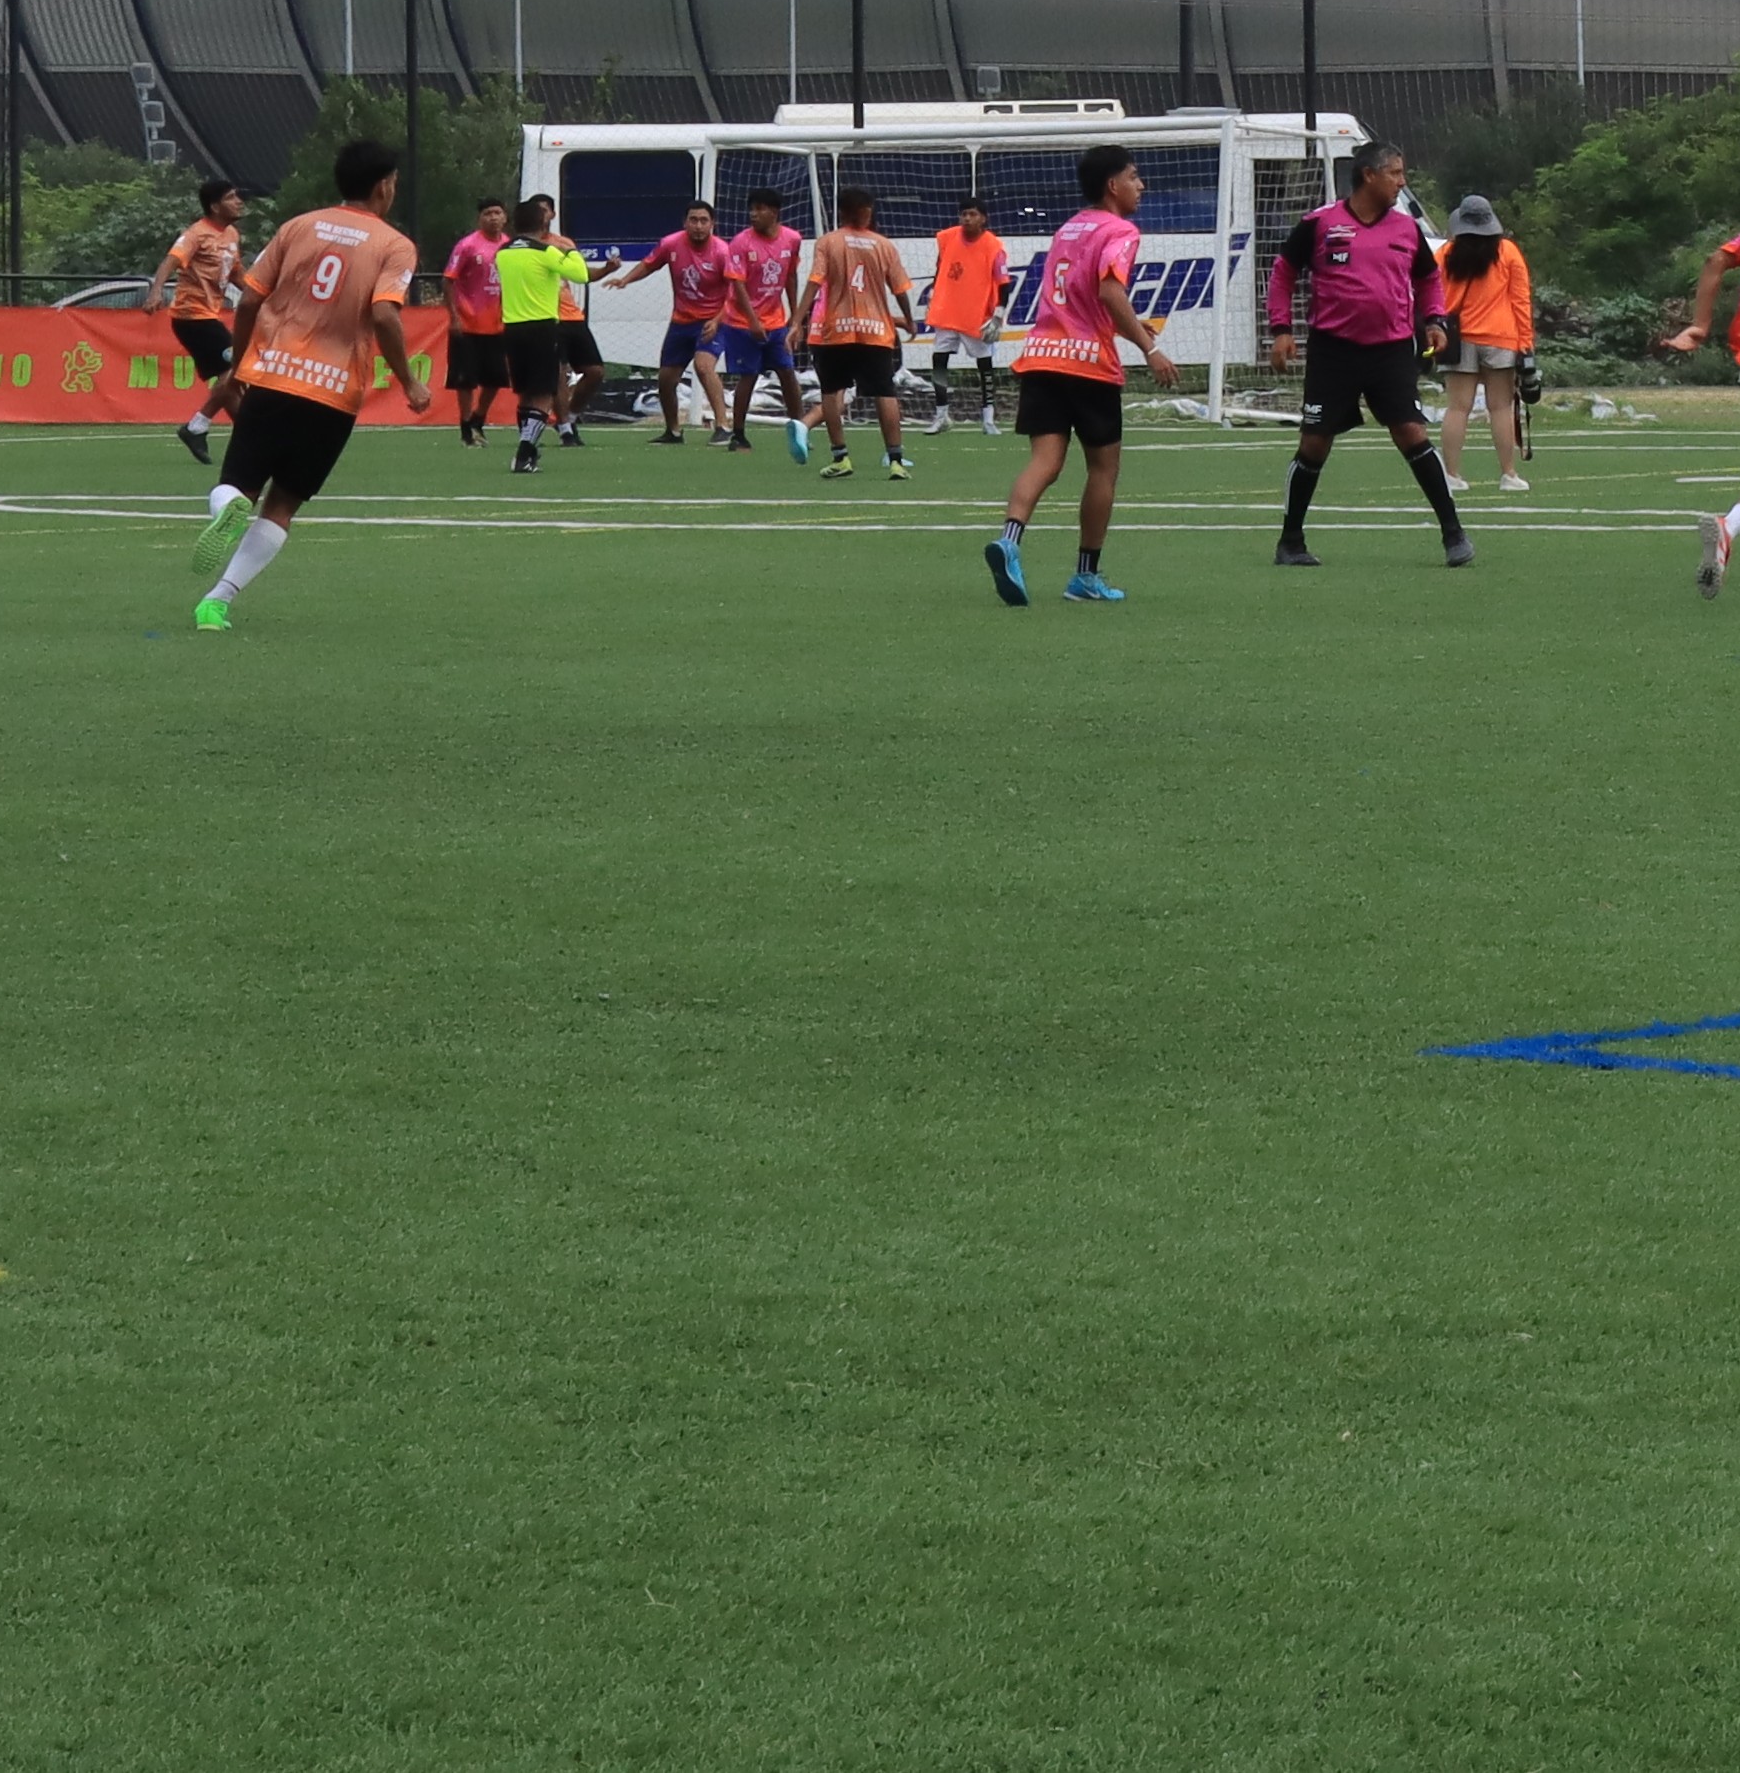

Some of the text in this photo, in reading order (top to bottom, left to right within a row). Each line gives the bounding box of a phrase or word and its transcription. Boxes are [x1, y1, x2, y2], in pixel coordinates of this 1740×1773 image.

[311, 255, 343, 301] 9
[851, 264, 865, 293] 4
[1052, 261, 1070, 305] 5
